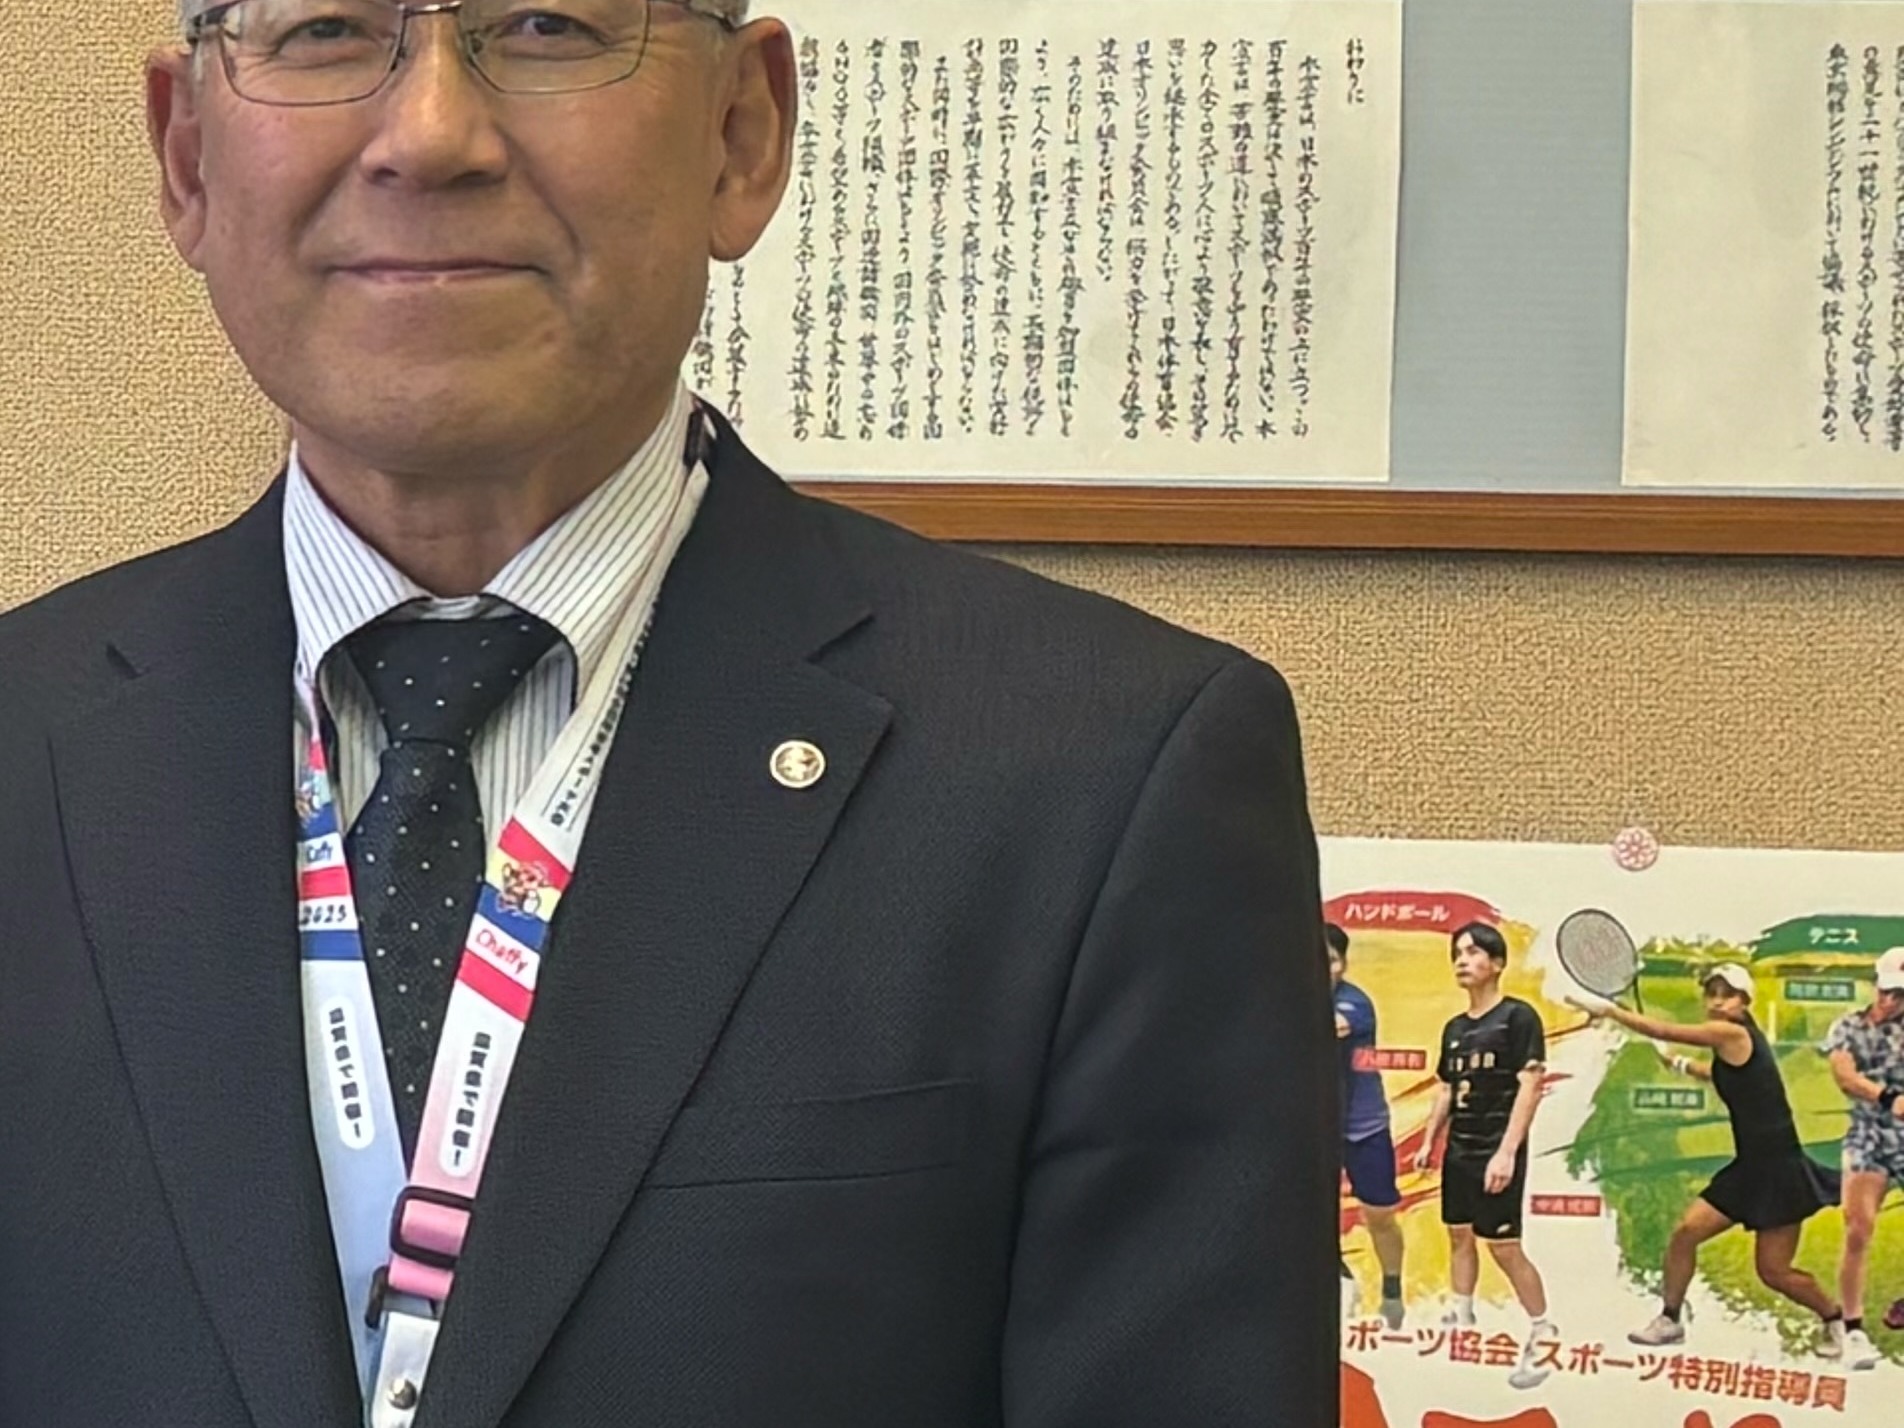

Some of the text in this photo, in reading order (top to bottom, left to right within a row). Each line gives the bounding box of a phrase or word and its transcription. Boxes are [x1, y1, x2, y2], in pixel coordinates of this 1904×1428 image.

[1344, 902, 1451, 925] ハンドボール
[1807, 925, 1861, 946] テニス
